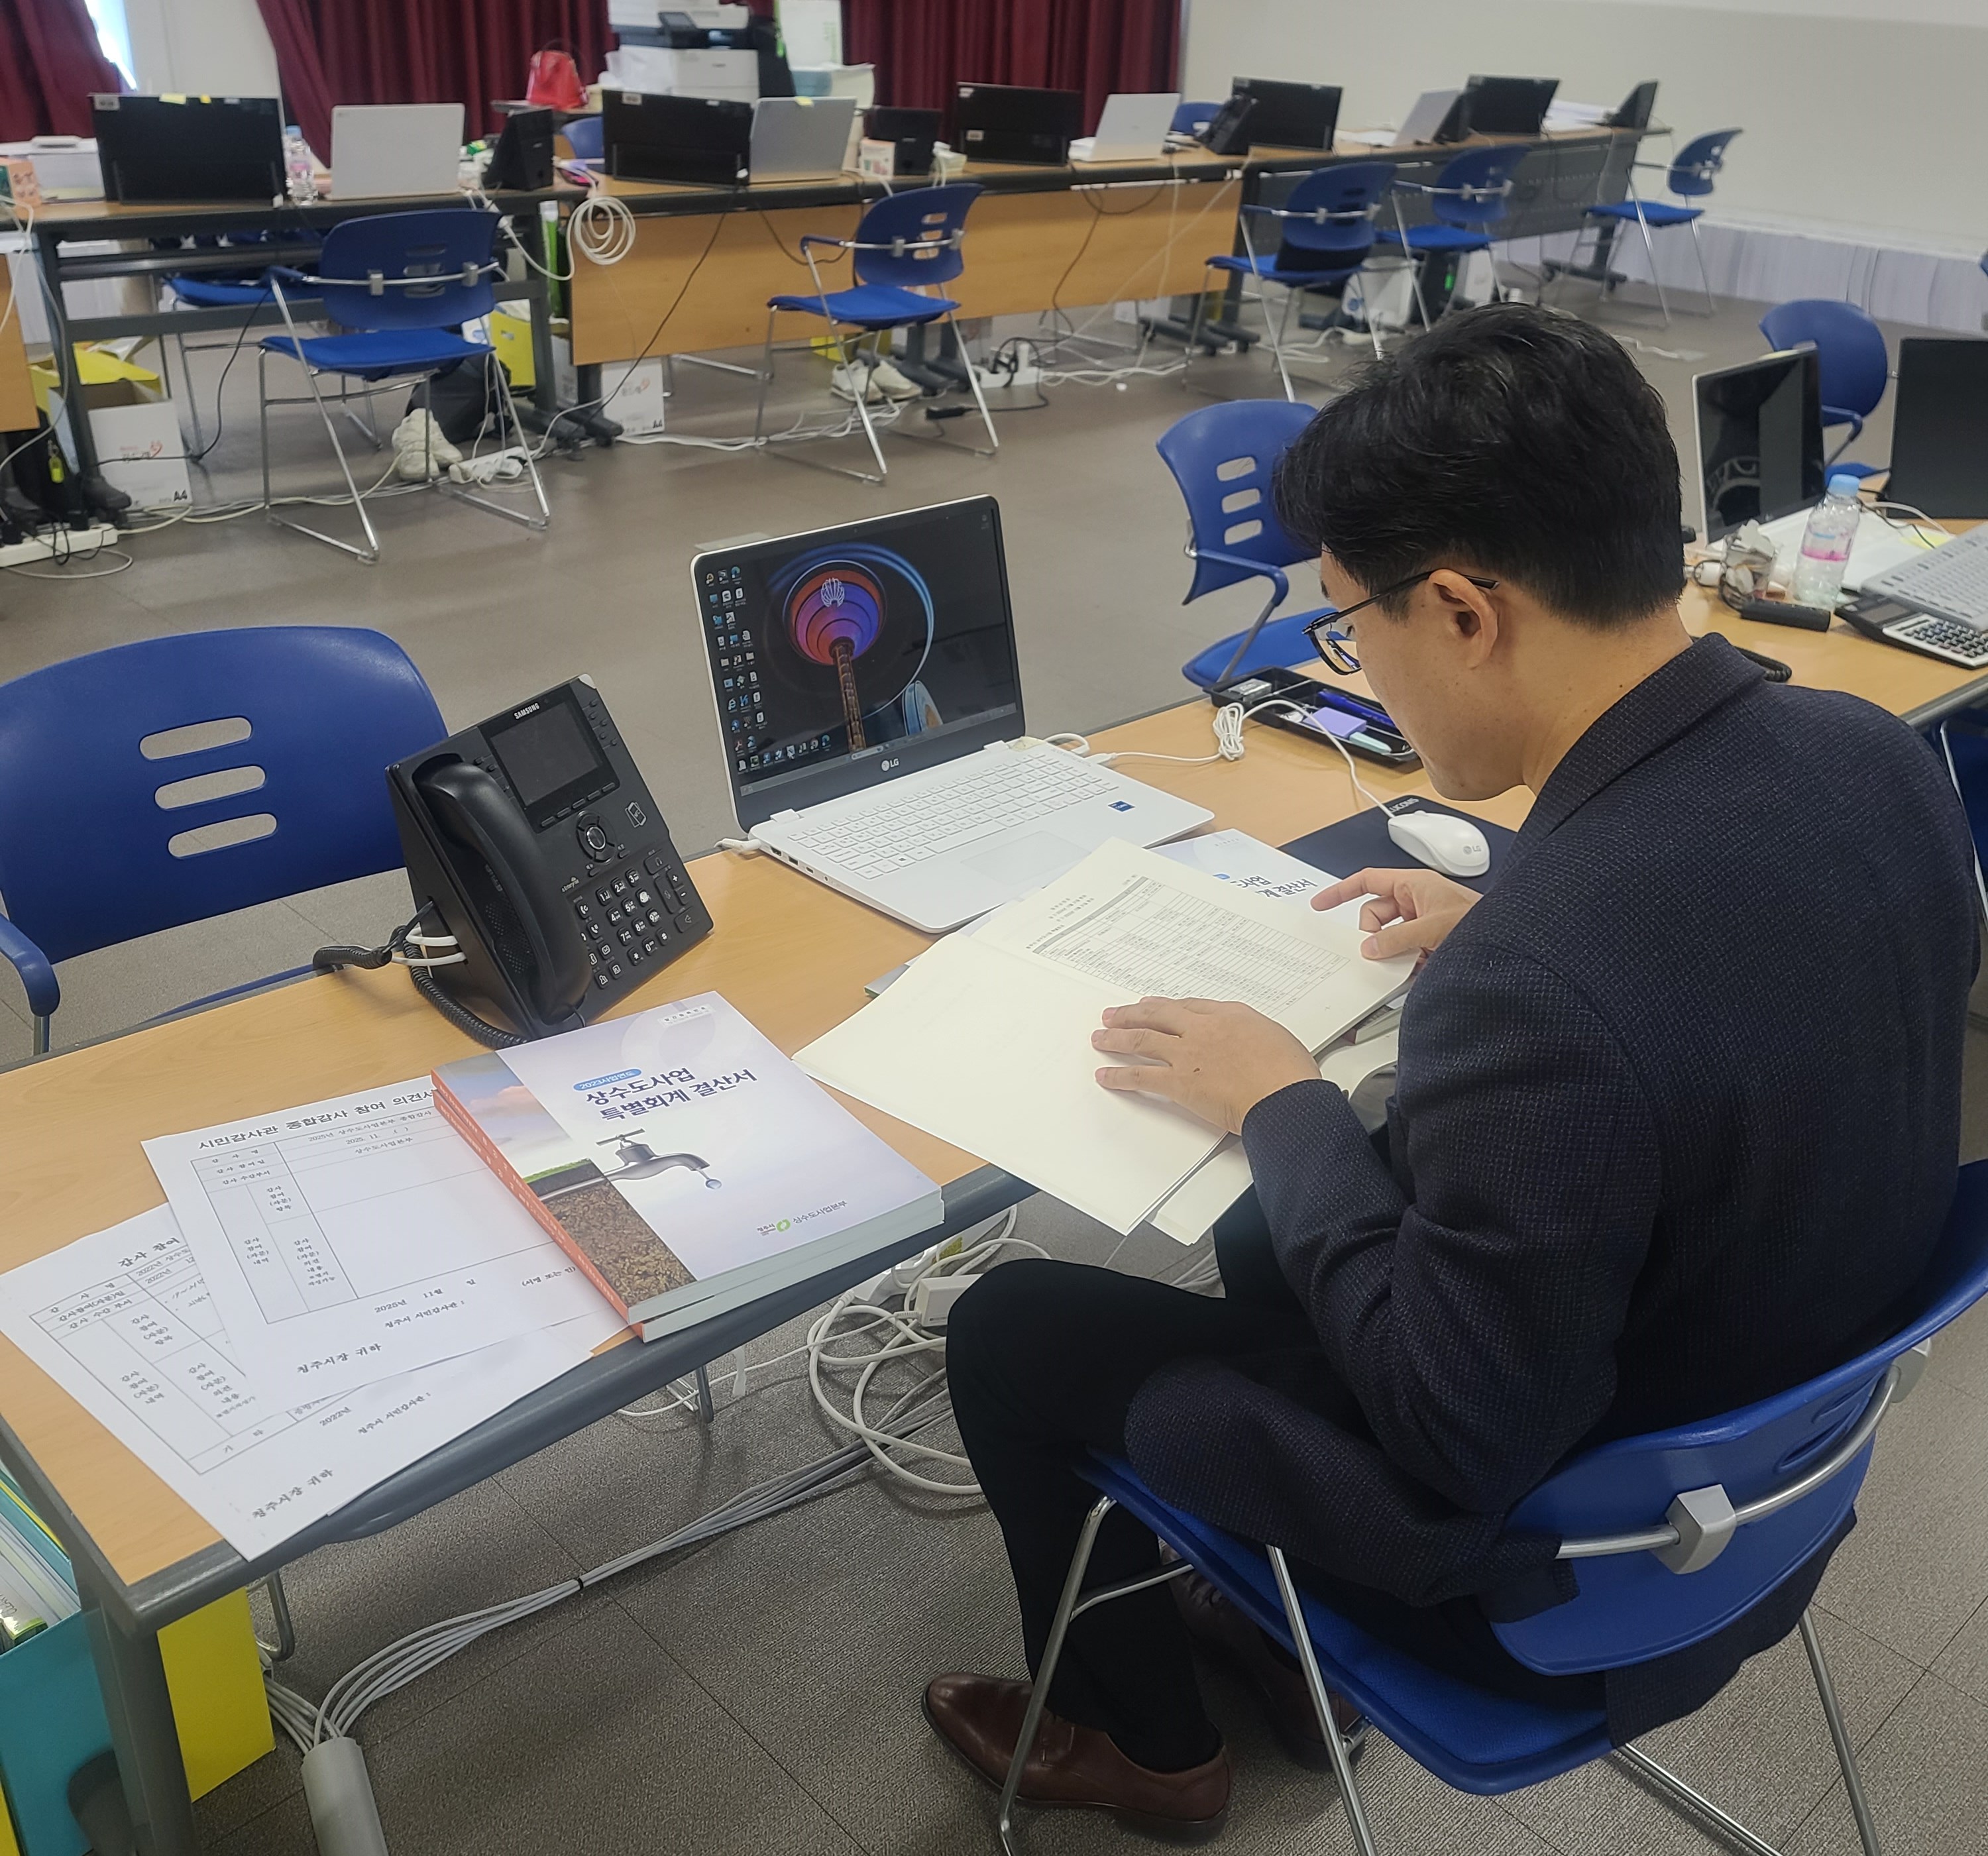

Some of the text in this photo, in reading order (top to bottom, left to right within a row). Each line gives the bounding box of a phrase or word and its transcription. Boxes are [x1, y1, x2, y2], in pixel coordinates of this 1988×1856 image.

[514, 702, 539, 719] SAMSUNG
[1390, 798, 1419, 812] UCOMS
[1272, 879, 1318, 895] 결산서
[586, 1067, 696, 1105] 상수도사업
[600, 1069, 757, 1120] 특별회계 결산서
[199, 1125, 278, 1150] 시민감사관
[286, 1109, 348, 1130] 종합감사
[354, 1101, 386, 1115] 참여
[793, 1200, 848, 1224] 상수도사업본부
[118, 1237, 180, 1268] 감사 참여
[374, 1299, 408, 1313] 2025년
[384, 1315, 412, 1328] 청주시
[414, 1301, 458, 1319] 시민감사관
[297, 1342, 382, 1374] 청주시장 귀하
[319, 1406, 352, 1426] 2022년
[358, 1417, 384, 1435] 청주시
[252, 1468, 334, 1518] 청주시장 귀하
